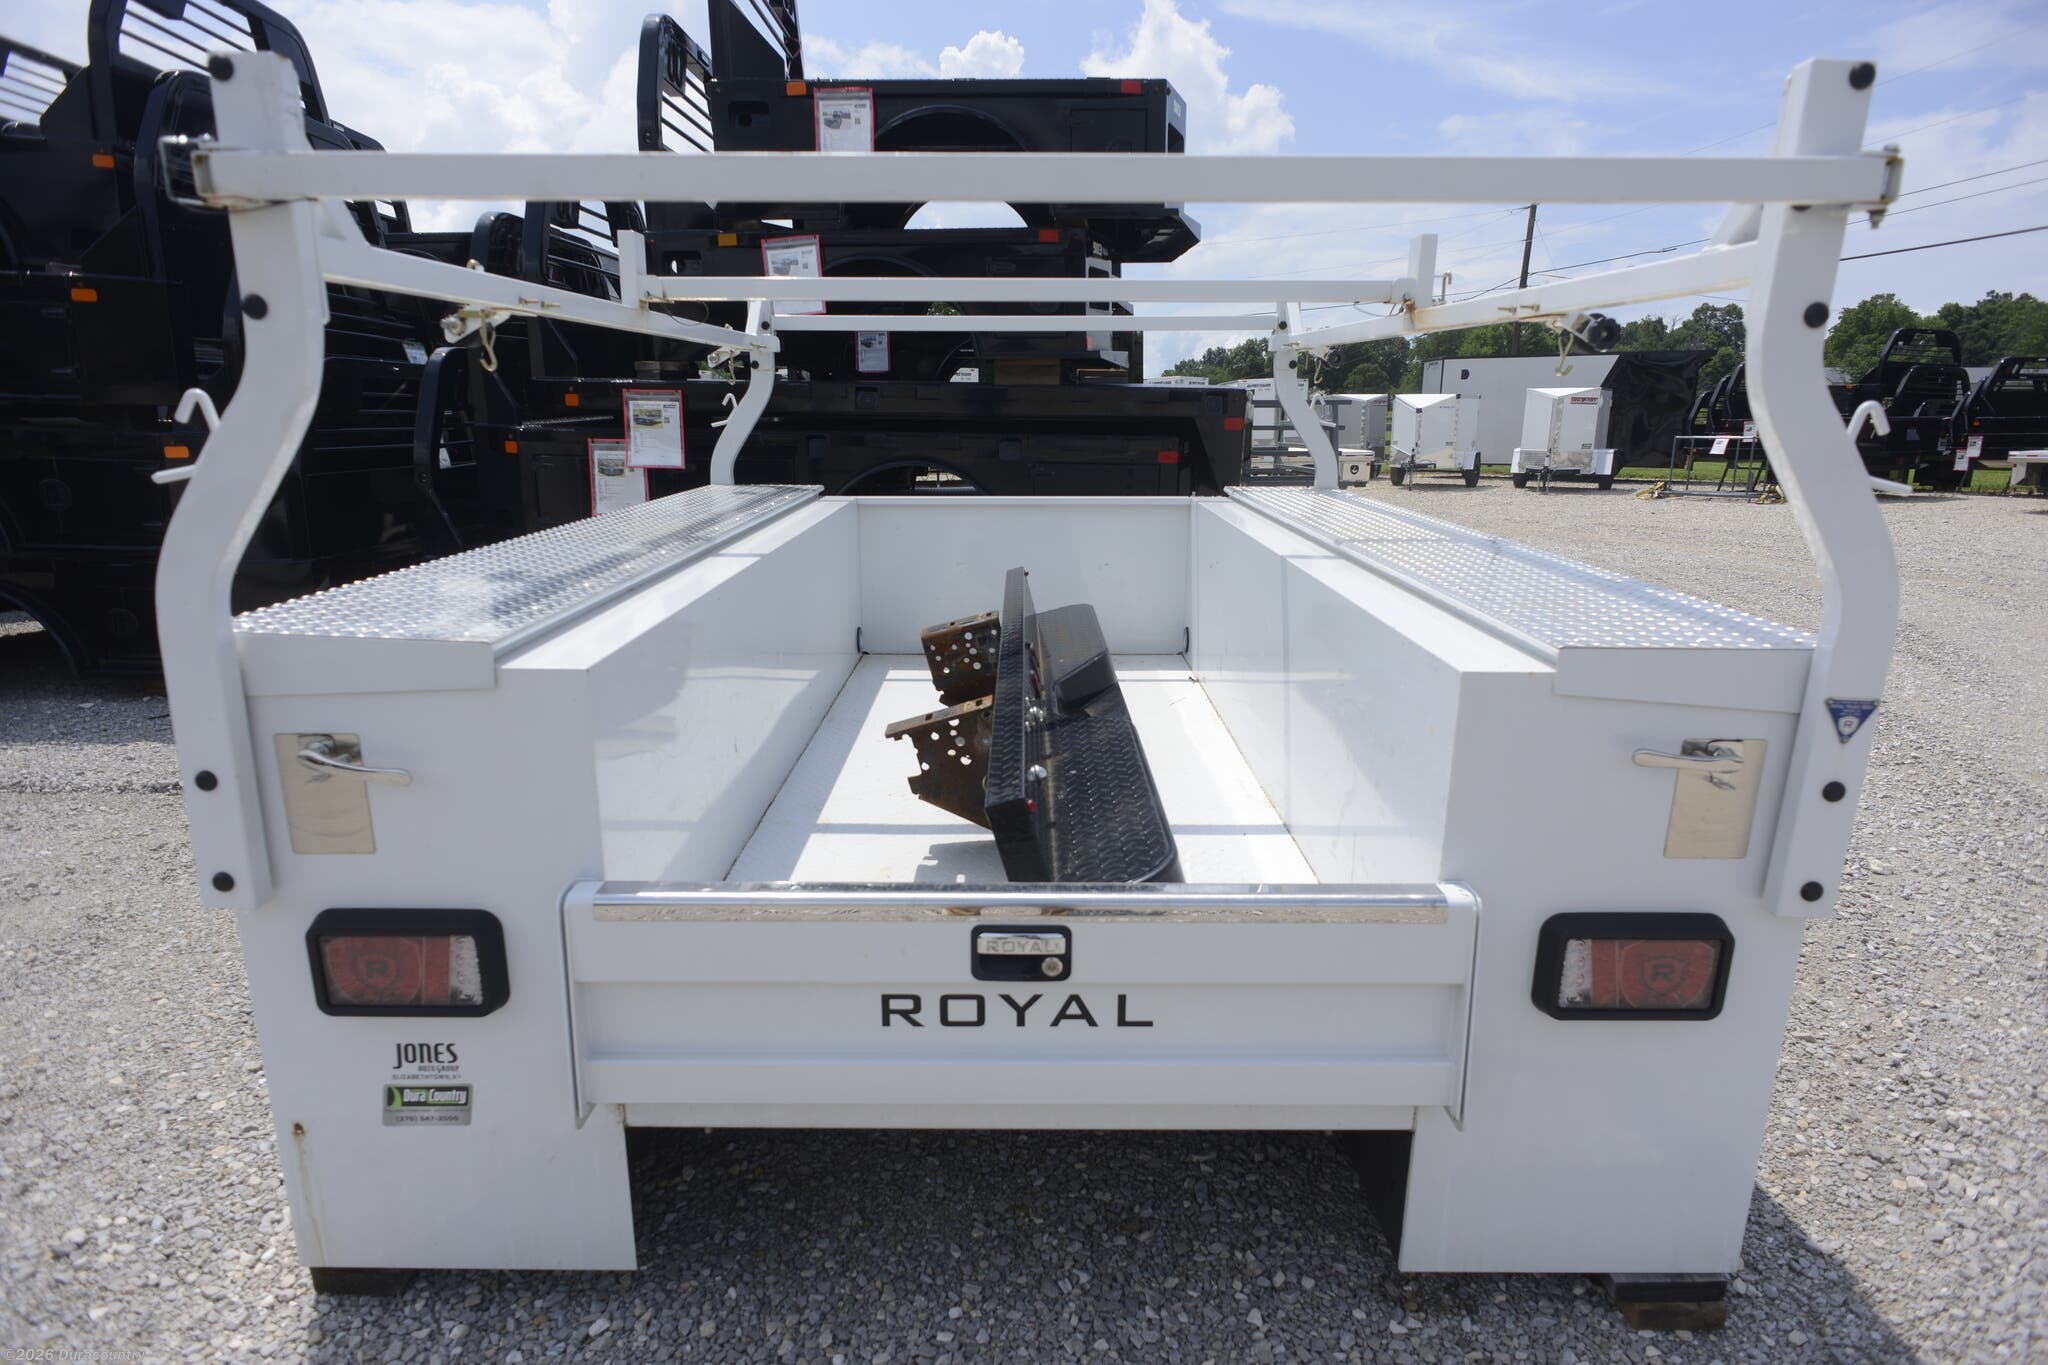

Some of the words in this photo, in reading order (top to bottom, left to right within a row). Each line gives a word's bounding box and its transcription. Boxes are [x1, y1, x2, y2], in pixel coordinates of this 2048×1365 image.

[986, 939, 1058, 952] ROYAL
[366, 960, 388, 977] R
[1652, 964, 1674, 981] R
[881, 993, 1154, 1027] ROYAL
[392, 1042, 458, 1069] JONES
[403, 1088, 426, 1103] Dura
[429, 1088, 467, 1104] Country
